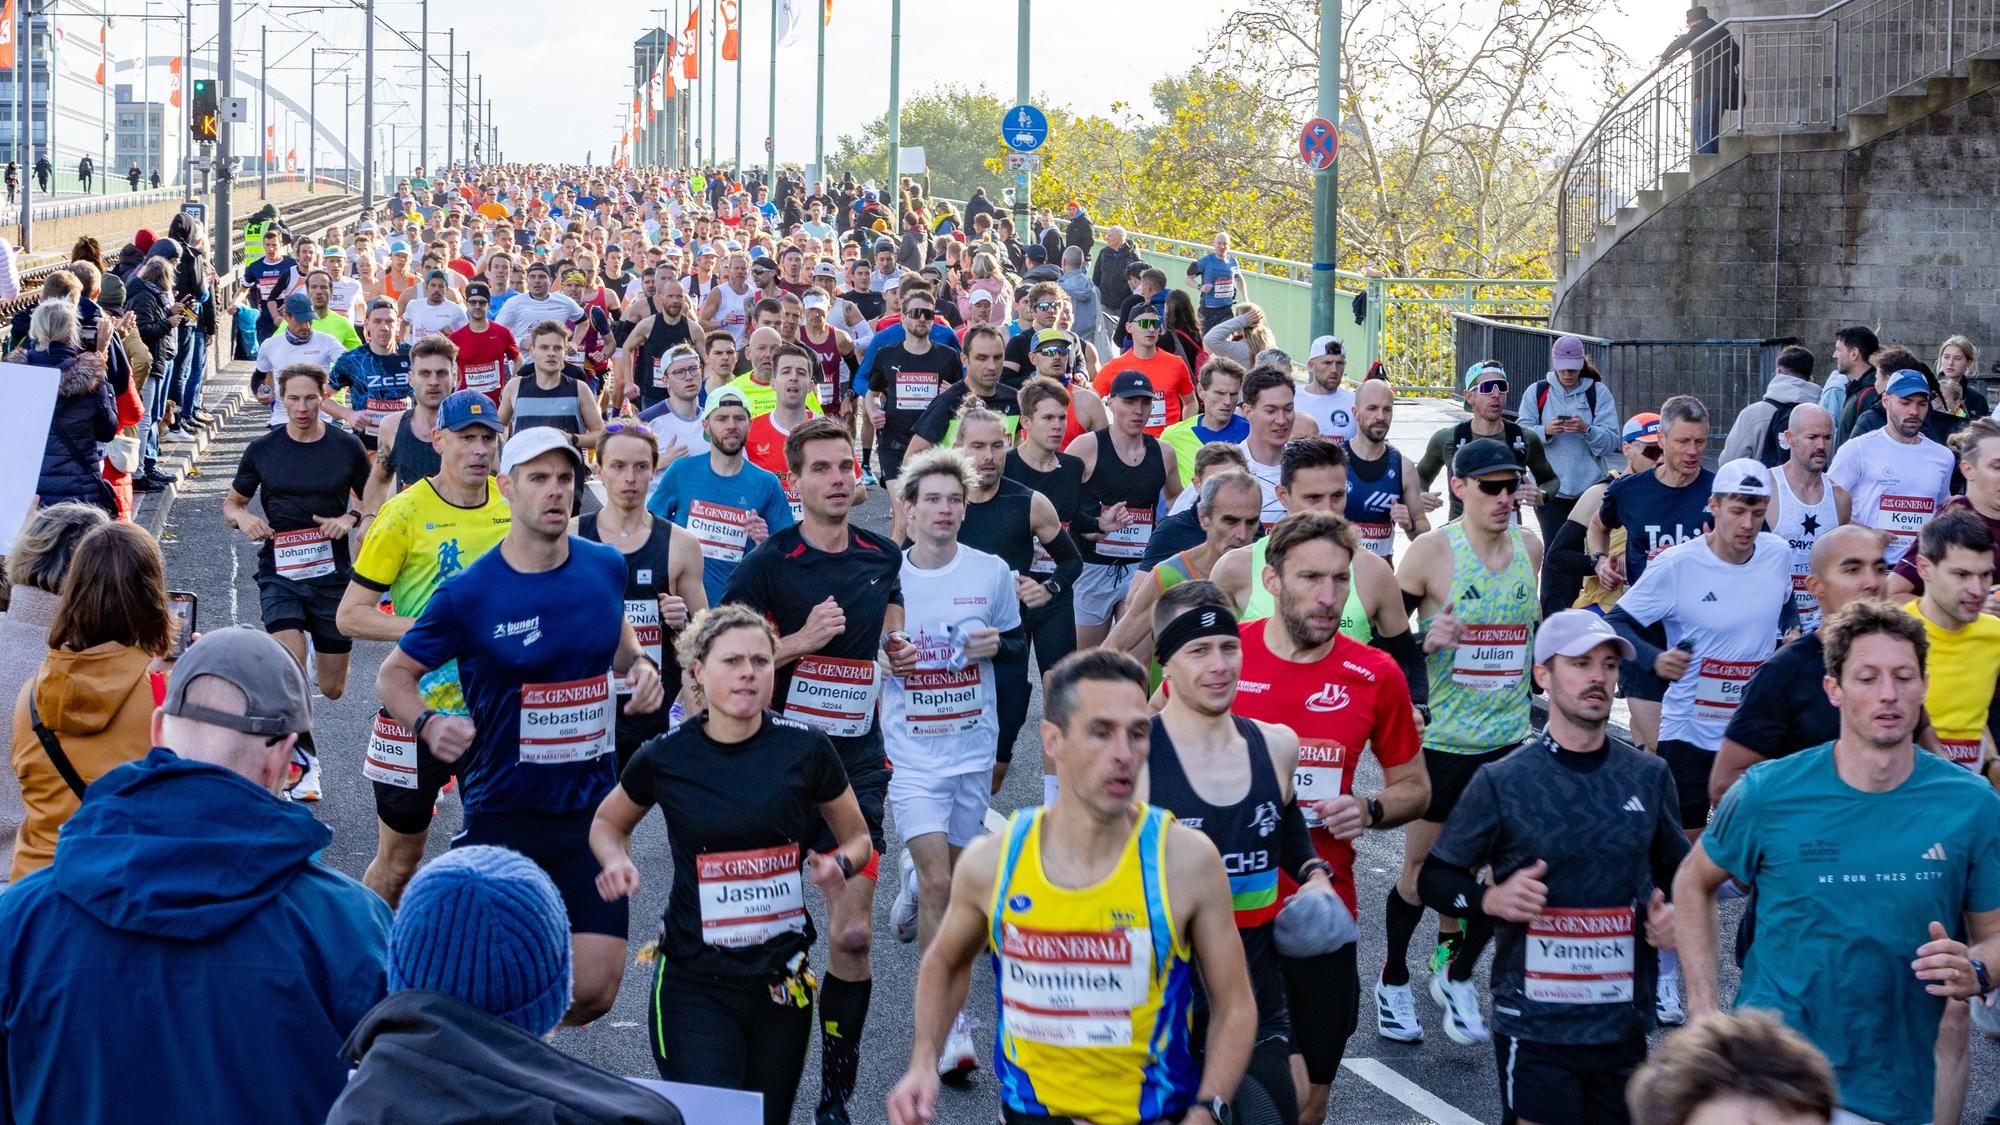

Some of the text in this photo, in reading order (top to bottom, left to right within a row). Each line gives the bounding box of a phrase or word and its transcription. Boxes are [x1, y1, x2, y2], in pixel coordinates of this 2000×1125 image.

[468, 372, 495, 381] Mathieu
[905, 384, 929, 393] David
[1894, 499, 1933, 510] GENERALI
[705, 507, 745, 523] GENERAL
[1891, 512, 1923, 524] Kevin
[691, 518, 744, 539] Christian
[278, 544, 329, 559] Johannes
[624, 602, 647, 613] ERS
[627, 614, 657, 624] ONIA
[1477, 629, 1527, 641] GENERALI
[1471, 646, 1514, 660] Julian
[817, 663, 873, 681] GENERALI
[923, 668, 978, 687] GENERALI
[545, 681, 607, 704] GENERALI
[796, 680, 867, 701] Domenico
[911, 687, 976, 707] Raphael
[821, 701, 842, 711] 32244
[527, 706, 604, 726] Sebastian
[724, 851, 798, 877] GENERALI
[1818, 871, 1943, 883] WE RUN THIS CITY
[716, 879, 791, 904] Jasmin
[1554, 915, 1632, 933] GENERALI
[1027, 934, 1129, 961] GENERALI
[1537, 938, 1626, 960] Yannick
[1009, 962, 1124, 992] Dominiek
